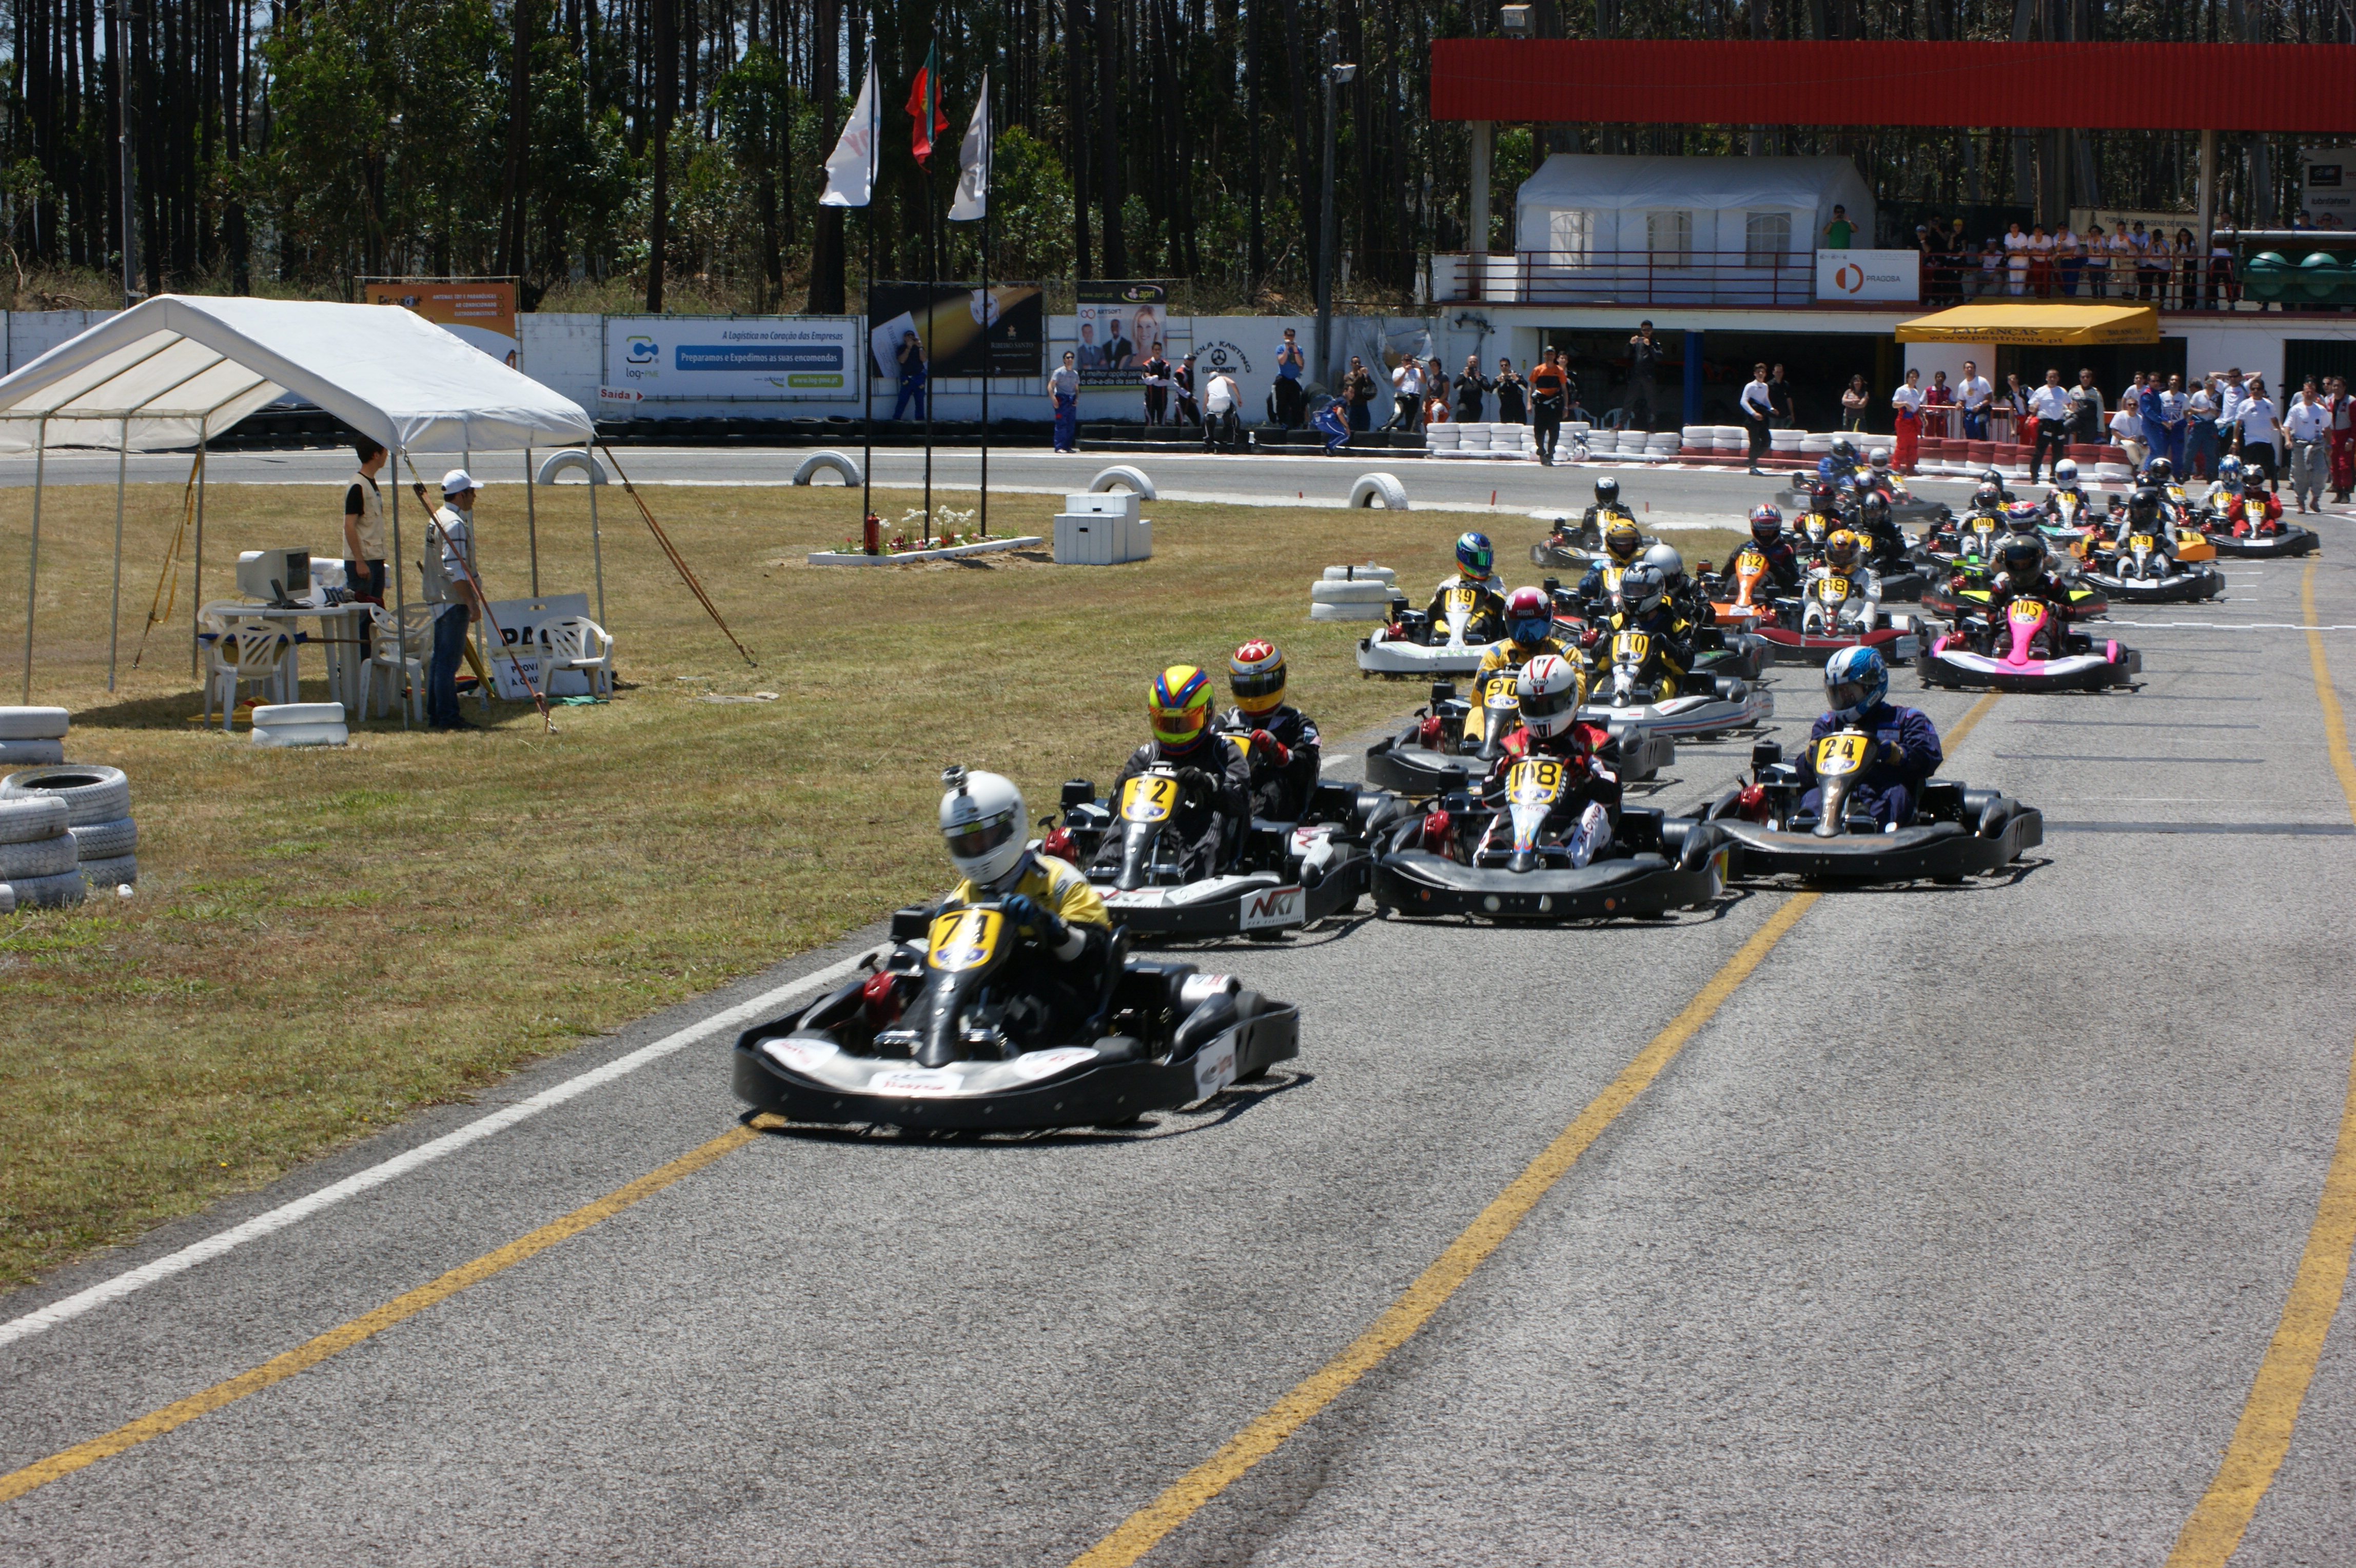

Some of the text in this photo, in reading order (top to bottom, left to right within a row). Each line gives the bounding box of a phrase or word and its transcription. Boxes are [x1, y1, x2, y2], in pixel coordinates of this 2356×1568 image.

[1139, 289, 1155, 300] apri
[722, 331, 727, 340] A
[729, 331, 759, 342] Logística
[770, 331, 796, 342] Coração
[798, 331, 810, 340] das
[811, 331, 843, 342] Empresas
[681, 352, 723, 363] Preparamos
[731, 353, 768, 363] Expedimos
[795, 354, 837, 362] encomendas
[1219, 341, 1252, 373] KARTING
[601, 388, 631, 400] Saída
[1741, 555, 1762, 567] 132
[1822, 579, 1845, 592] 88
[2016, 601, 2039, 616] 105
[1488, 680, 1517, 696] 90
[1823, 738, 1854, 759] 24
[1514, 762, 1557, 787] 108
[1129, 779, 1168, 805] 52
[1577, 805, 1601, 845] RACING
[1248, 887, 1302, 919] NKT
[940, 914, 989, 946] 71
